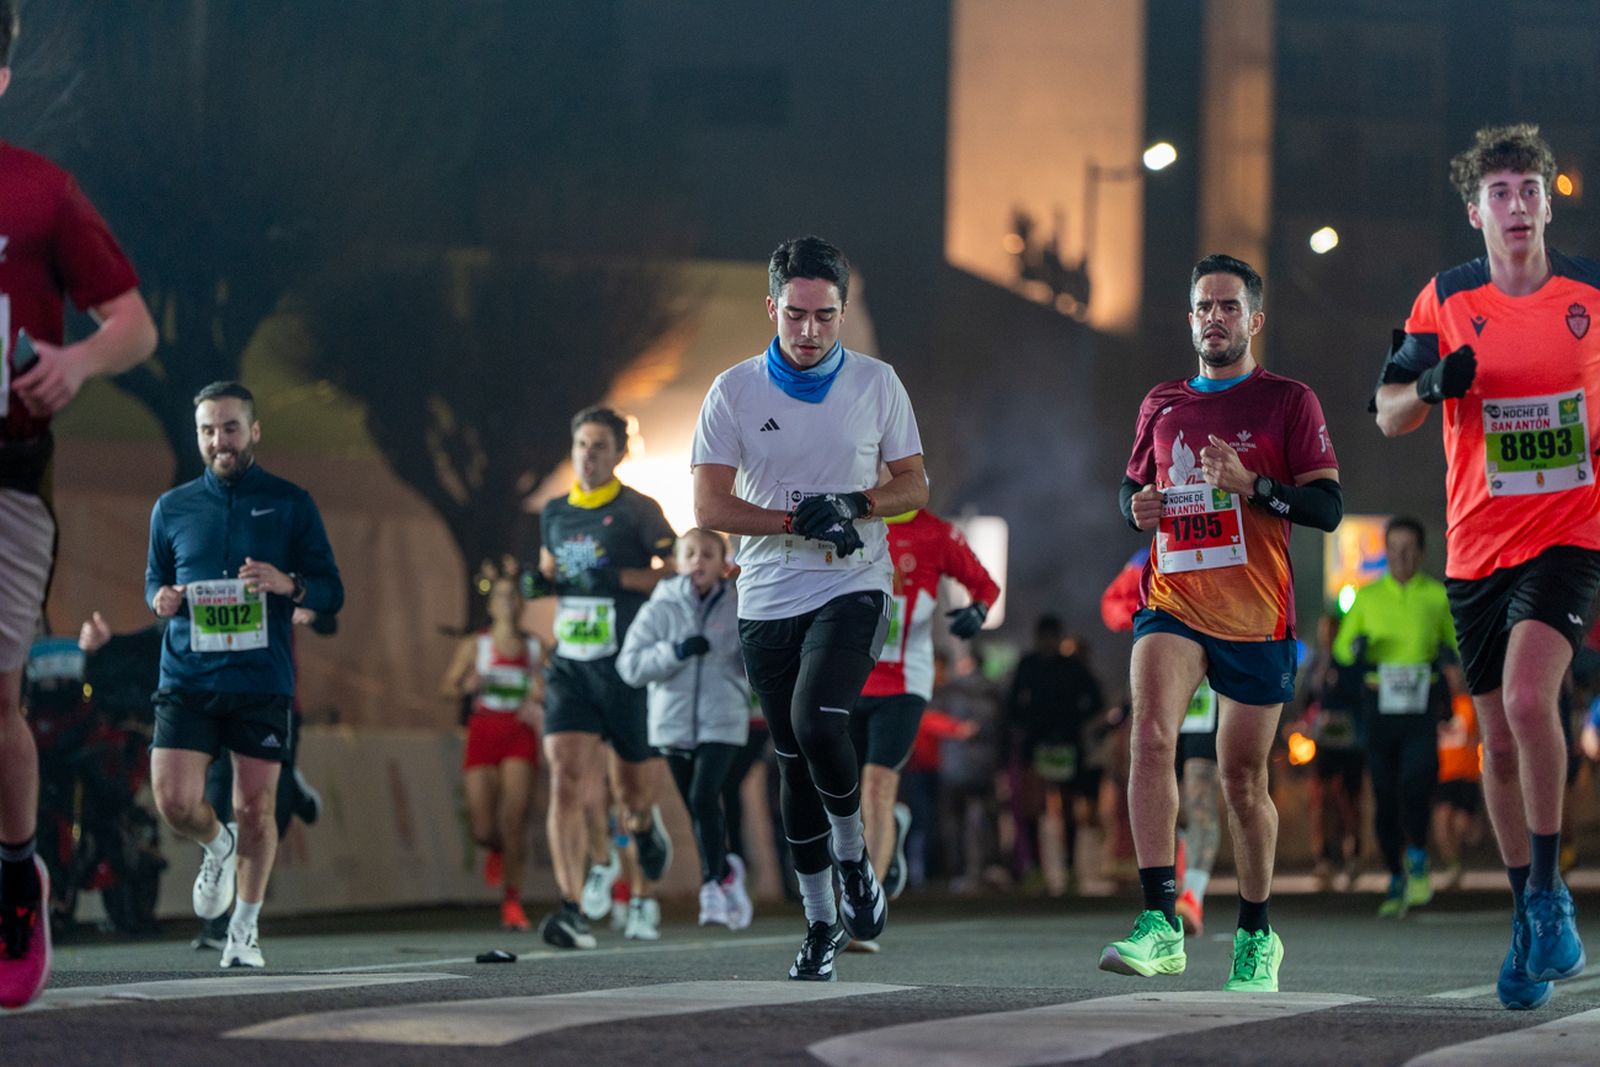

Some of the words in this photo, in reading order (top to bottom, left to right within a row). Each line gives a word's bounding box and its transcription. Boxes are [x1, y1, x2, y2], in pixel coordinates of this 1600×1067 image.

[1503, 408, 1534, 419] NOCHE
[1537, 406, 1549, 417] DE
[1491, 421, 1512, 432] SAN
[1515, 418, 1550, 430] ANTÓN
[1500, 427, 1573, 462] 8893
[1169, 495, 1193, 505] NOCHE
[1194, 493, 1205, 502] DE
[1163, 506, 1176, 516] SAN
[1177, 501, 1206, 515] ANTÓN
[1171, 512, 1223, 542] 1795
[205, 604, 251, 627] 3012
